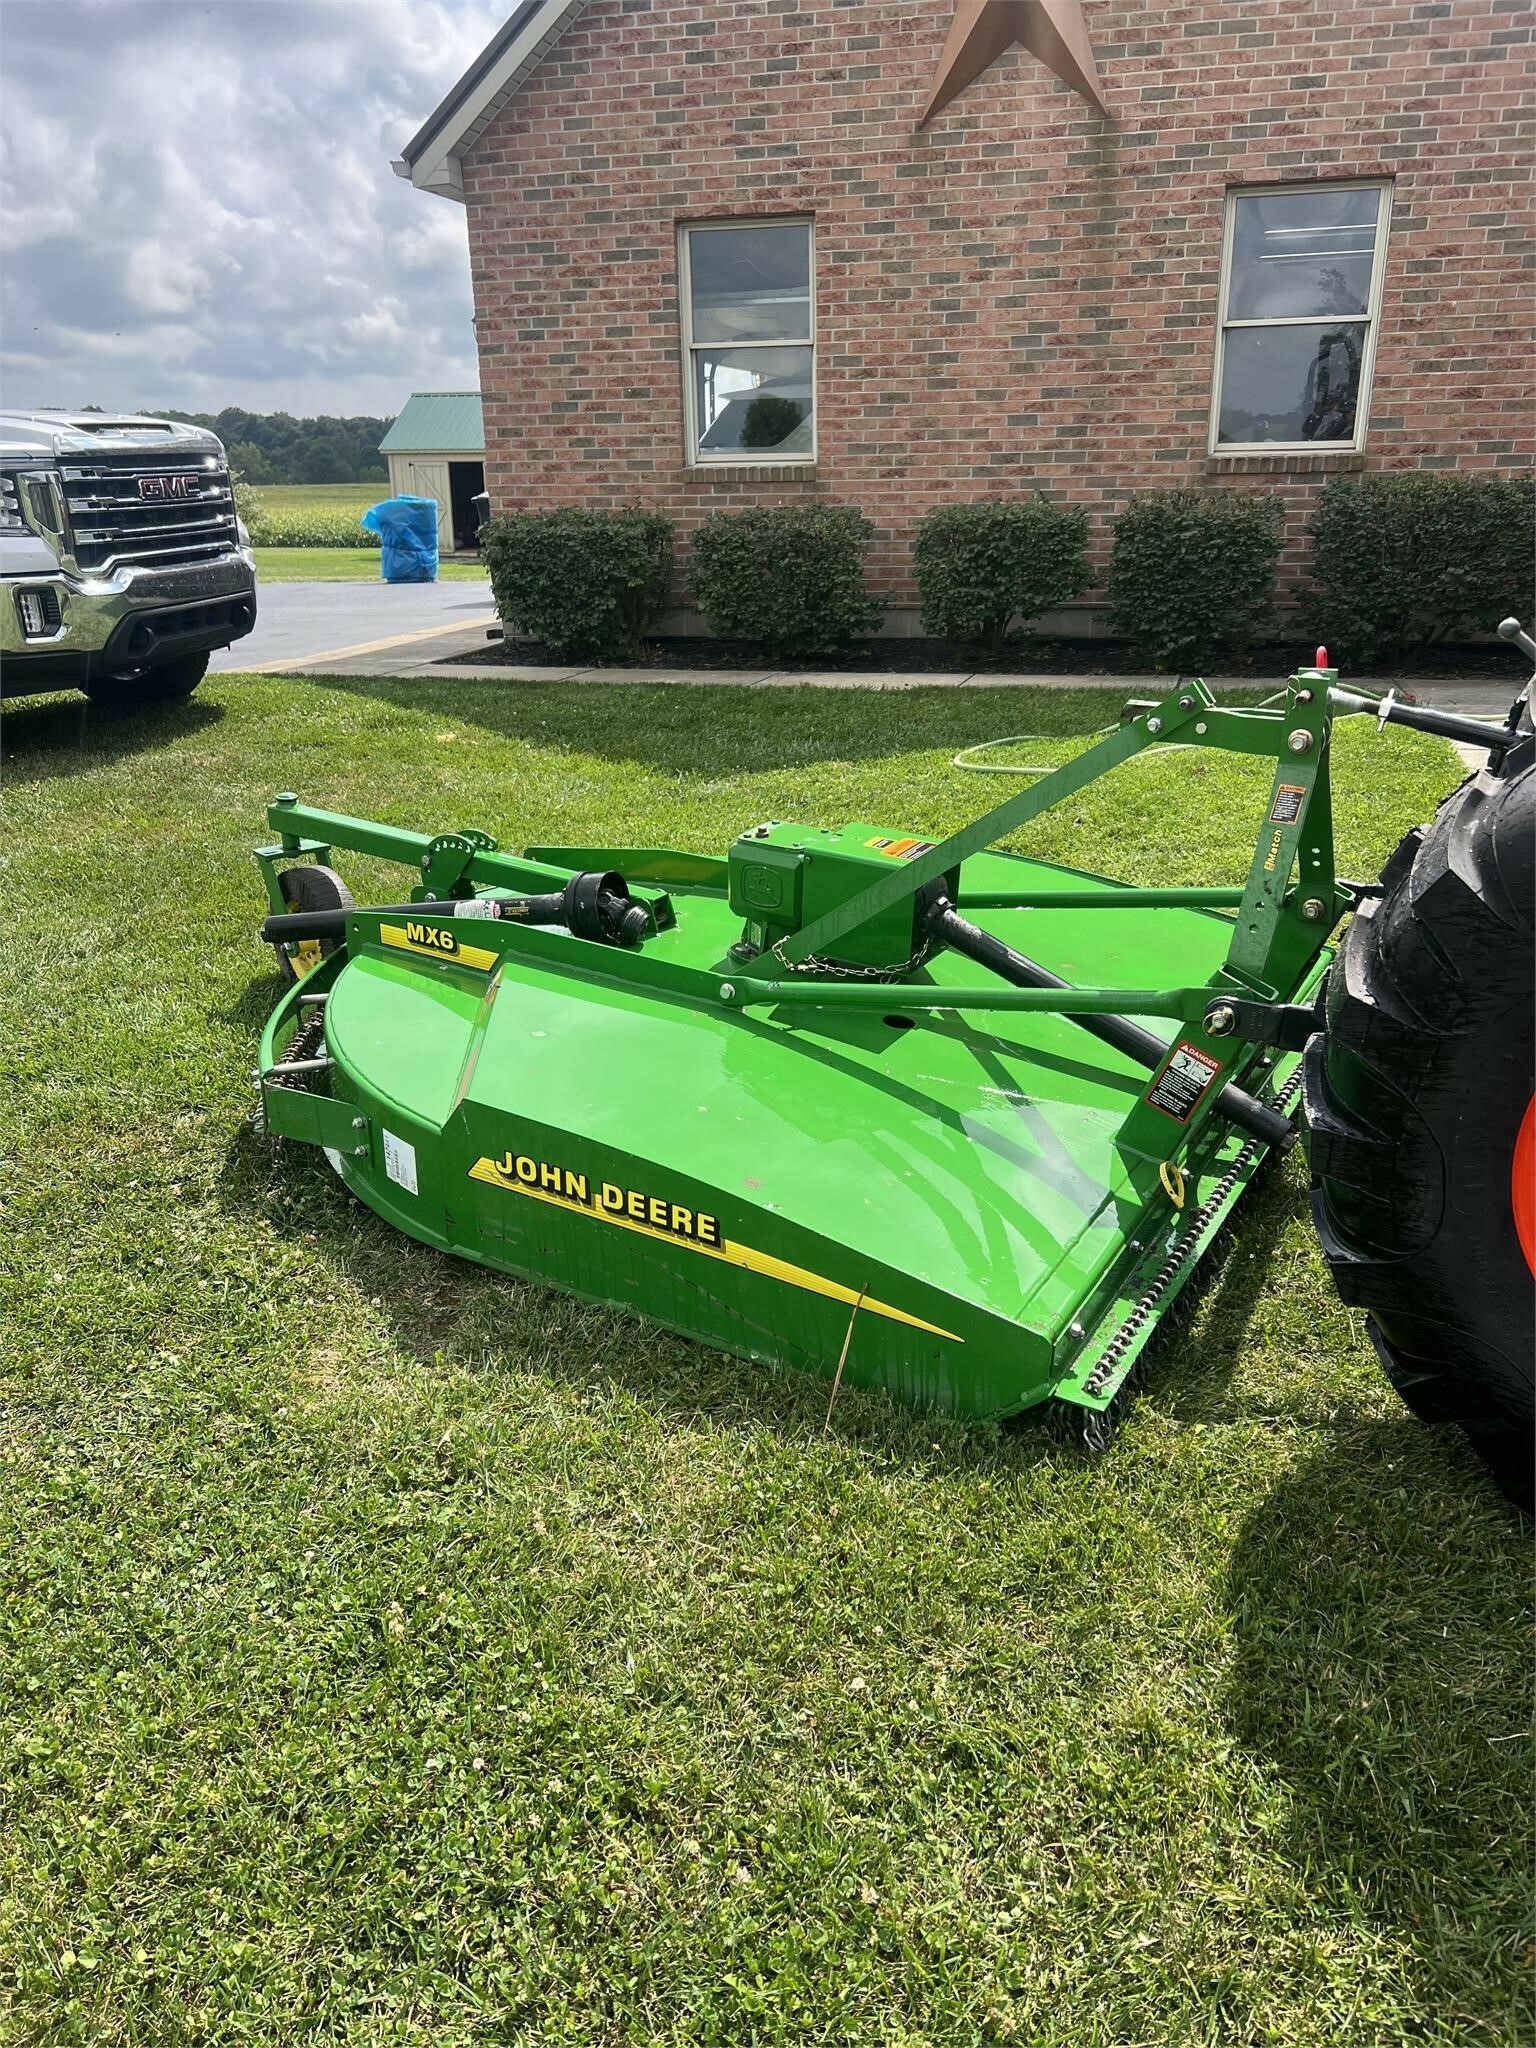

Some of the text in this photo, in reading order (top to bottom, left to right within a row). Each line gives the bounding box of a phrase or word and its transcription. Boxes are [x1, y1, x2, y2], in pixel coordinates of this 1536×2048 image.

[138, 476, 200, 500] GMC
[406, 921, 455, 950] MX6
[1188, 1048, 1219, 1069] DANGER
[495, 1150, 717, 1243] JOHN DEERE
